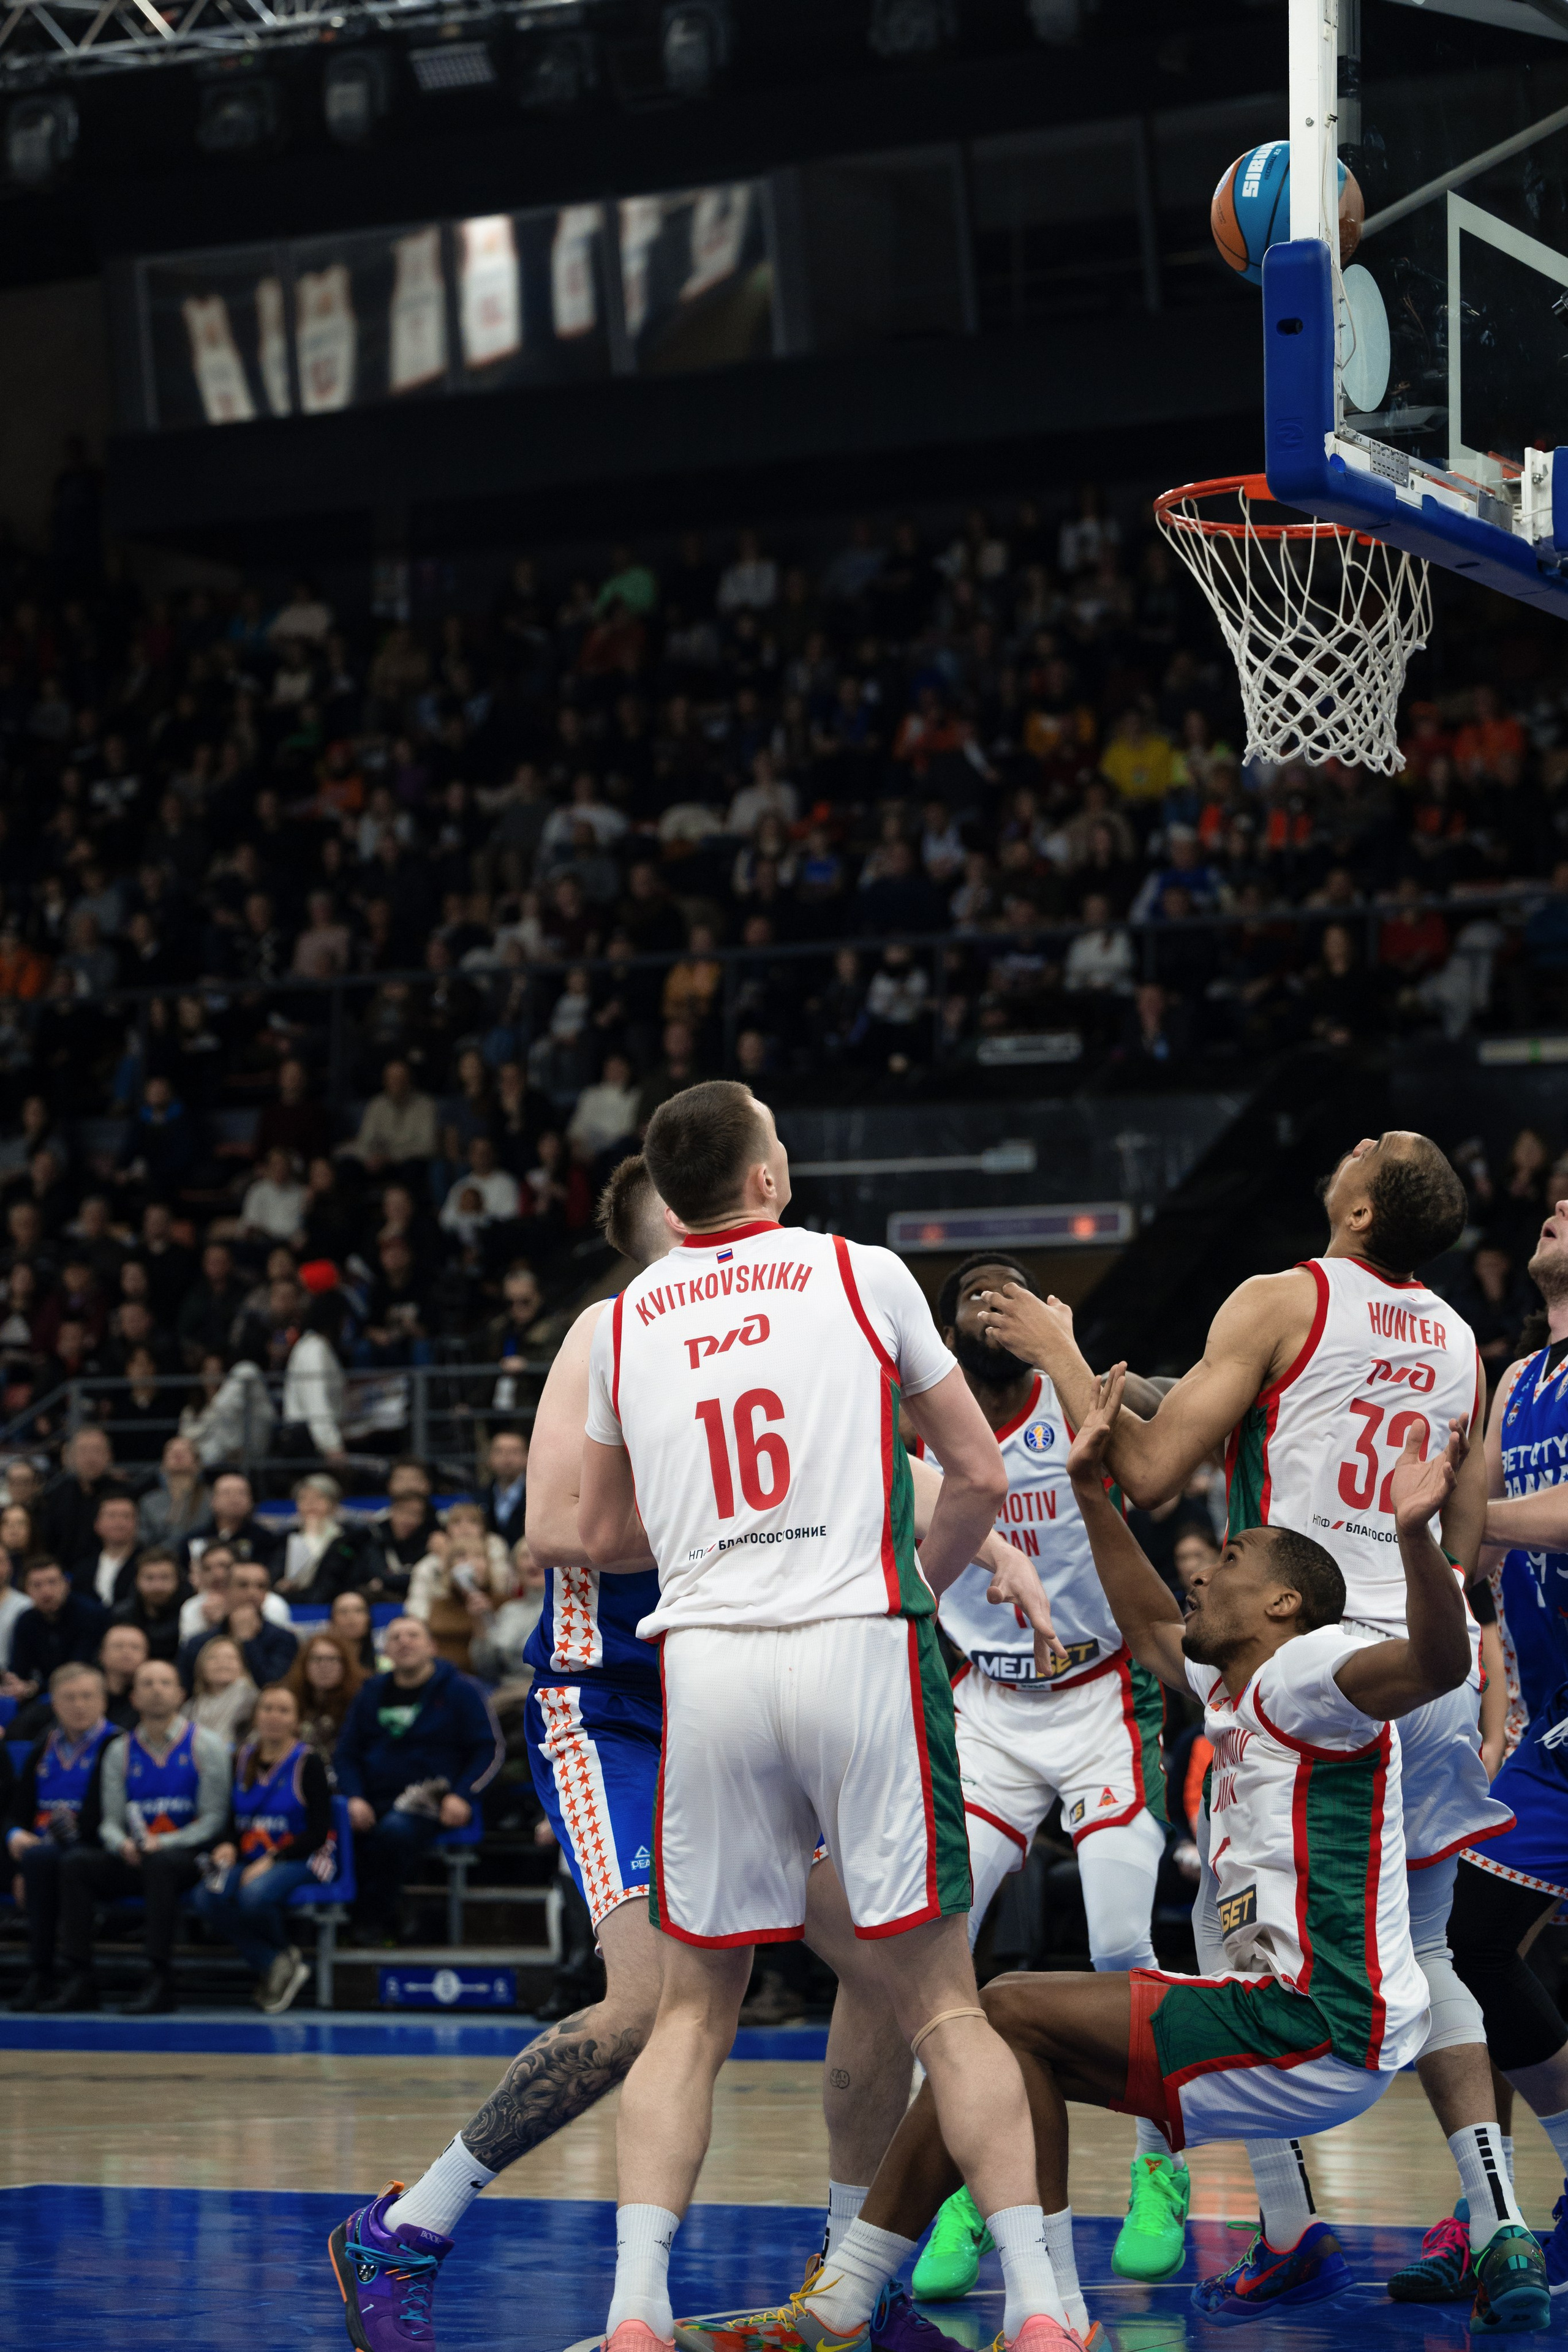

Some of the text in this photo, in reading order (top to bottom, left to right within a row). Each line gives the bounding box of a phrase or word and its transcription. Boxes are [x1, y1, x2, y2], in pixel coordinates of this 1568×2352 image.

[635, 1262, 813, 1327] KVITKOVSKIKH
[1367, 1302, 1447, 1351] HUNTER
[695, 1388, 791, 1520] 16
[718, 1525, 827, 1551] БЛАГОСОСОЯНИЕ
[1312, 1513, 1398, 1544] НПФ БЛАГОСОС
[630, 1860, 650, 1871] PEA
